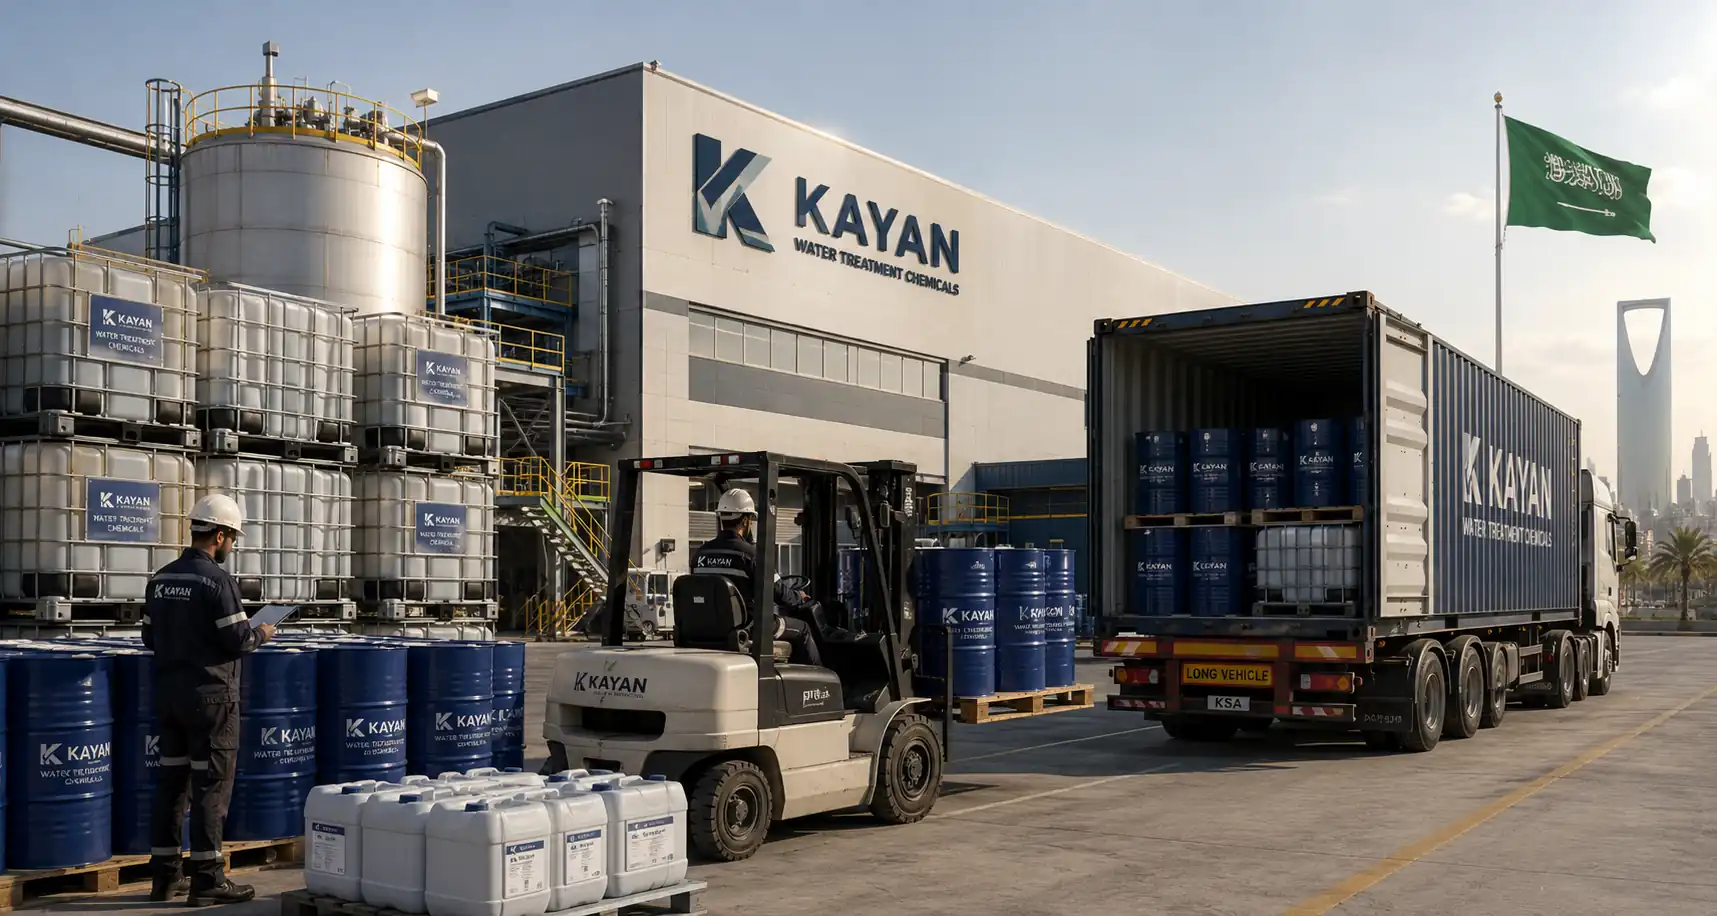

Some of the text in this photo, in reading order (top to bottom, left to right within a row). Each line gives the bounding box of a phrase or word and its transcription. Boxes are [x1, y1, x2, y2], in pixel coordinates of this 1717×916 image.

[795, 176, 959, 274] KAYAN
[793, 237, 960, 296] WATER TREATMENT CHEMICALS
[118, 314, 153, 328] KAYAN
[436, 365, 461, 375] KAYAN
[1489, 445, 1552, 520] KAYAN
[116, 495, 151, 506] KAYAN
[1462, 516, 1486, 538] WATER
[707, 558, 732, 567] KAYAN
[164, 586, 192, 597] KAYAN
[1186, 667, 1269, 681] LONG VEHICLE
[588, 675, 648, 694] KAYAN
[1215, 697, 1242, 709] KSA
[67, 741, 111, 761] KAYAN
